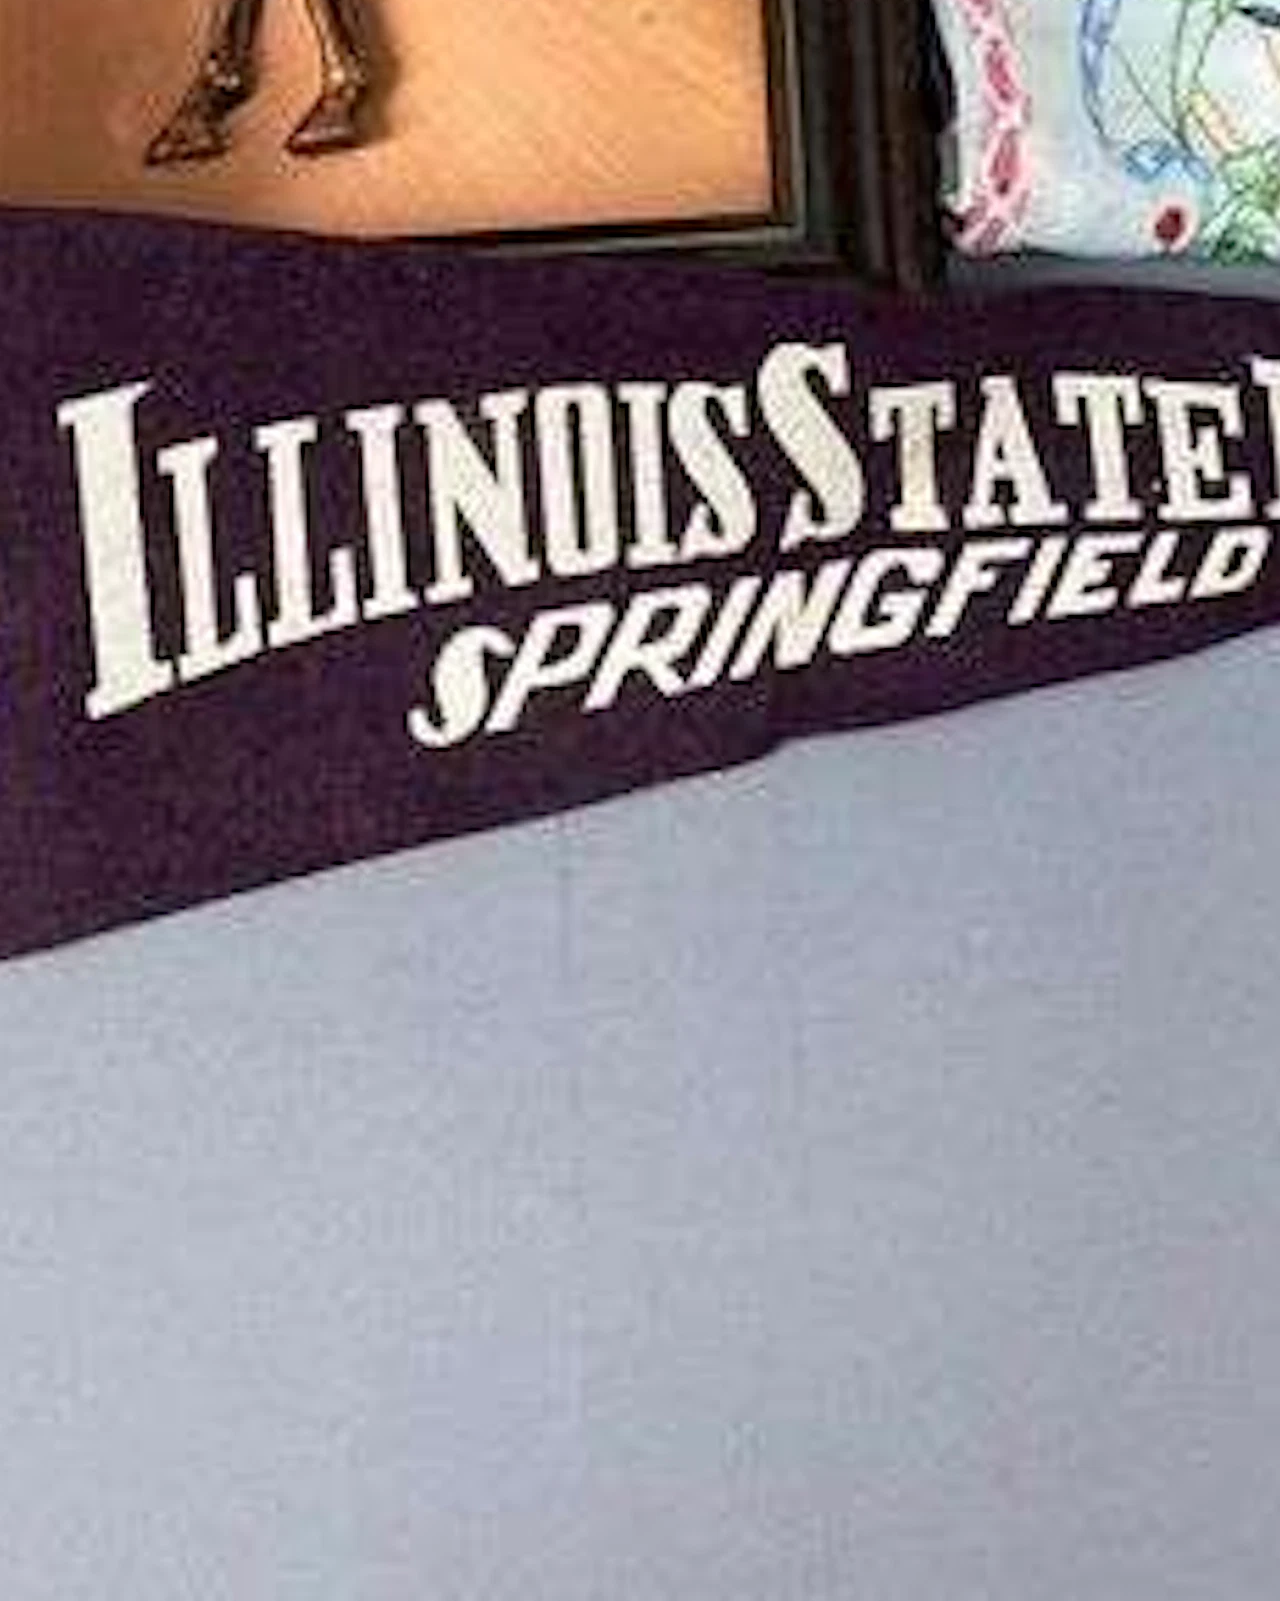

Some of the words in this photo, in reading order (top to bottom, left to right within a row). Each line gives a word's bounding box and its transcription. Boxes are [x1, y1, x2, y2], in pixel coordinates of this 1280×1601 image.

[56, 380, 757, 720] ILLINOIS
[757, 342, 1248, 552] STATE
[408, 525, 1270, 747] SPRINGFIELD
